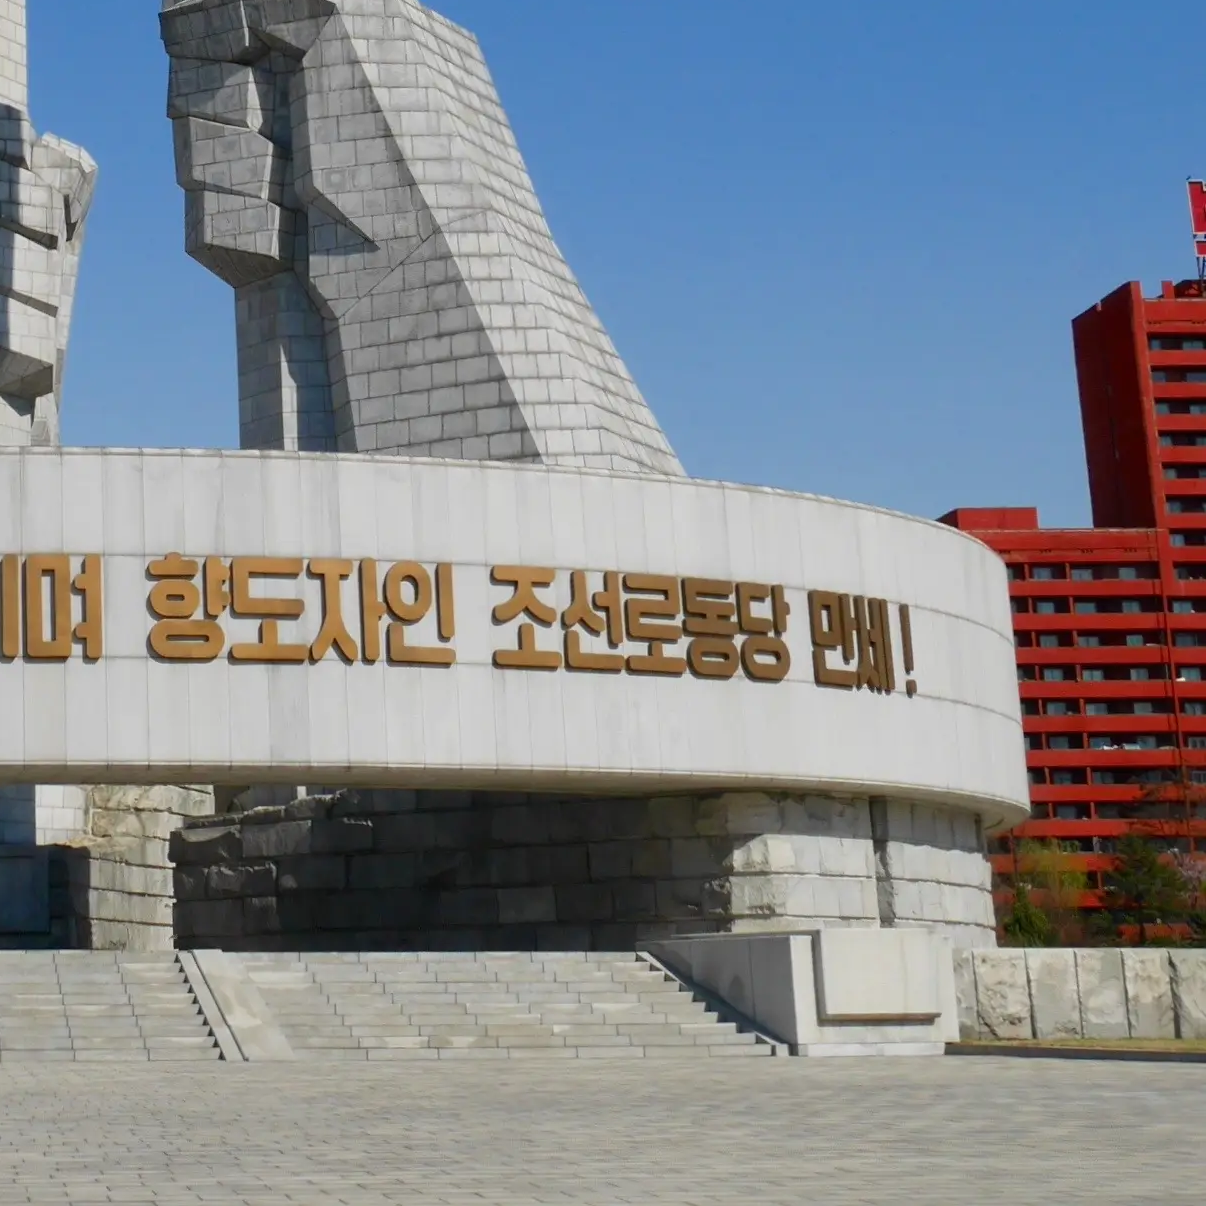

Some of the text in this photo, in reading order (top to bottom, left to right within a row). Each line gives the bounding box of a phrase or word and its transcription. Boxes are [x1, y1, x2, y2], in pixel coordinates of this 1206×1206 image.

[147, 552, 456, 665] 향도자인
[491, 565, 791, 682] 조선로동당
[808, 590, 918, 696] 만세!
